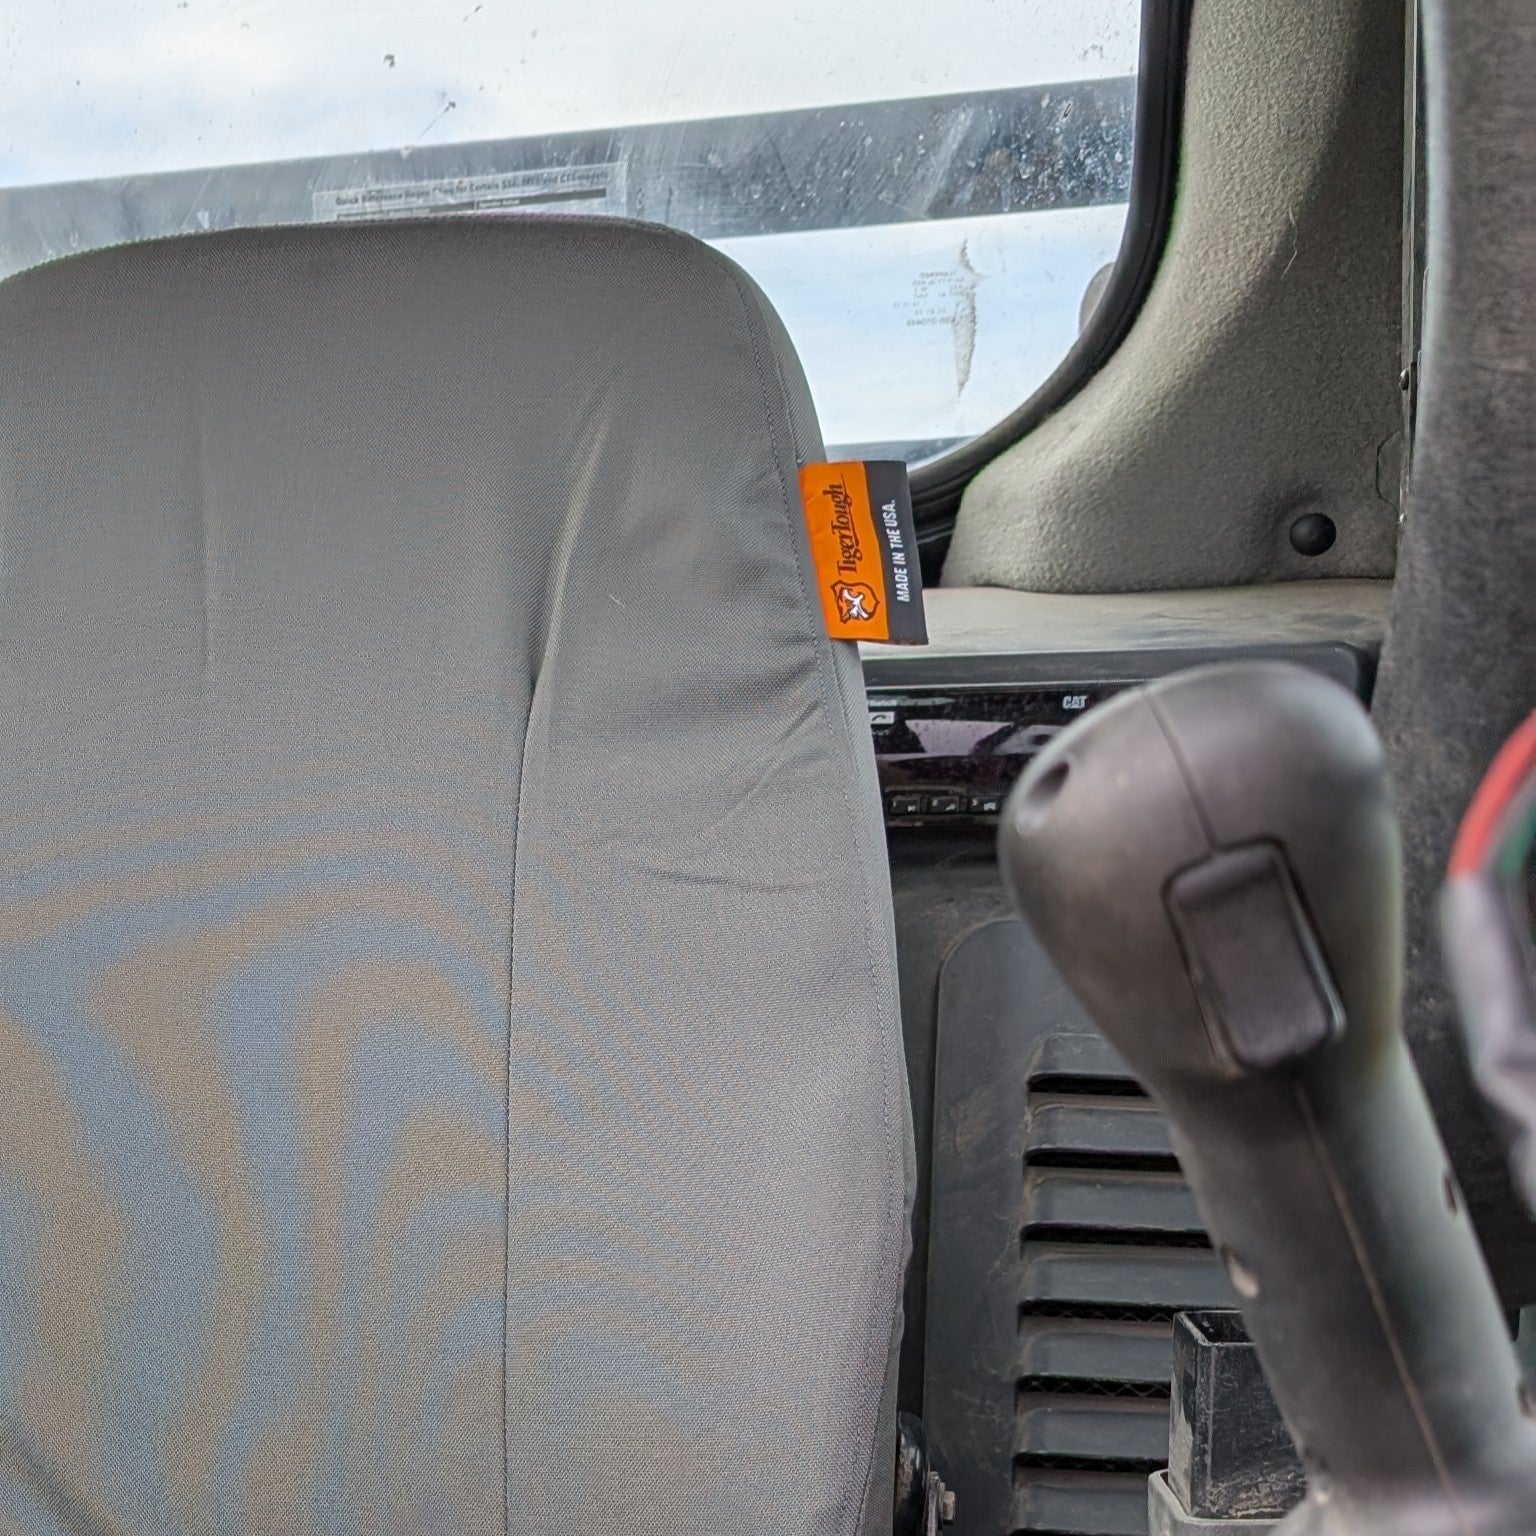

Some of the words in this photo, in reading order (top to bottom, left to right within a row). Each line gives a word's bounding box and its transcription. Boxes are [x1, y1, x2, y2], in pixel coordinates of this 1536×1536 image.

[881, 499, 898, 527] USA.
[823, 480, 862, 576] TigerTough
[886, 527, 904, 549] THE
[892, 551, 906, 565] IN
[894, 566, 910, 602] MADE
[1063, 695, 1088, 709] CAT
